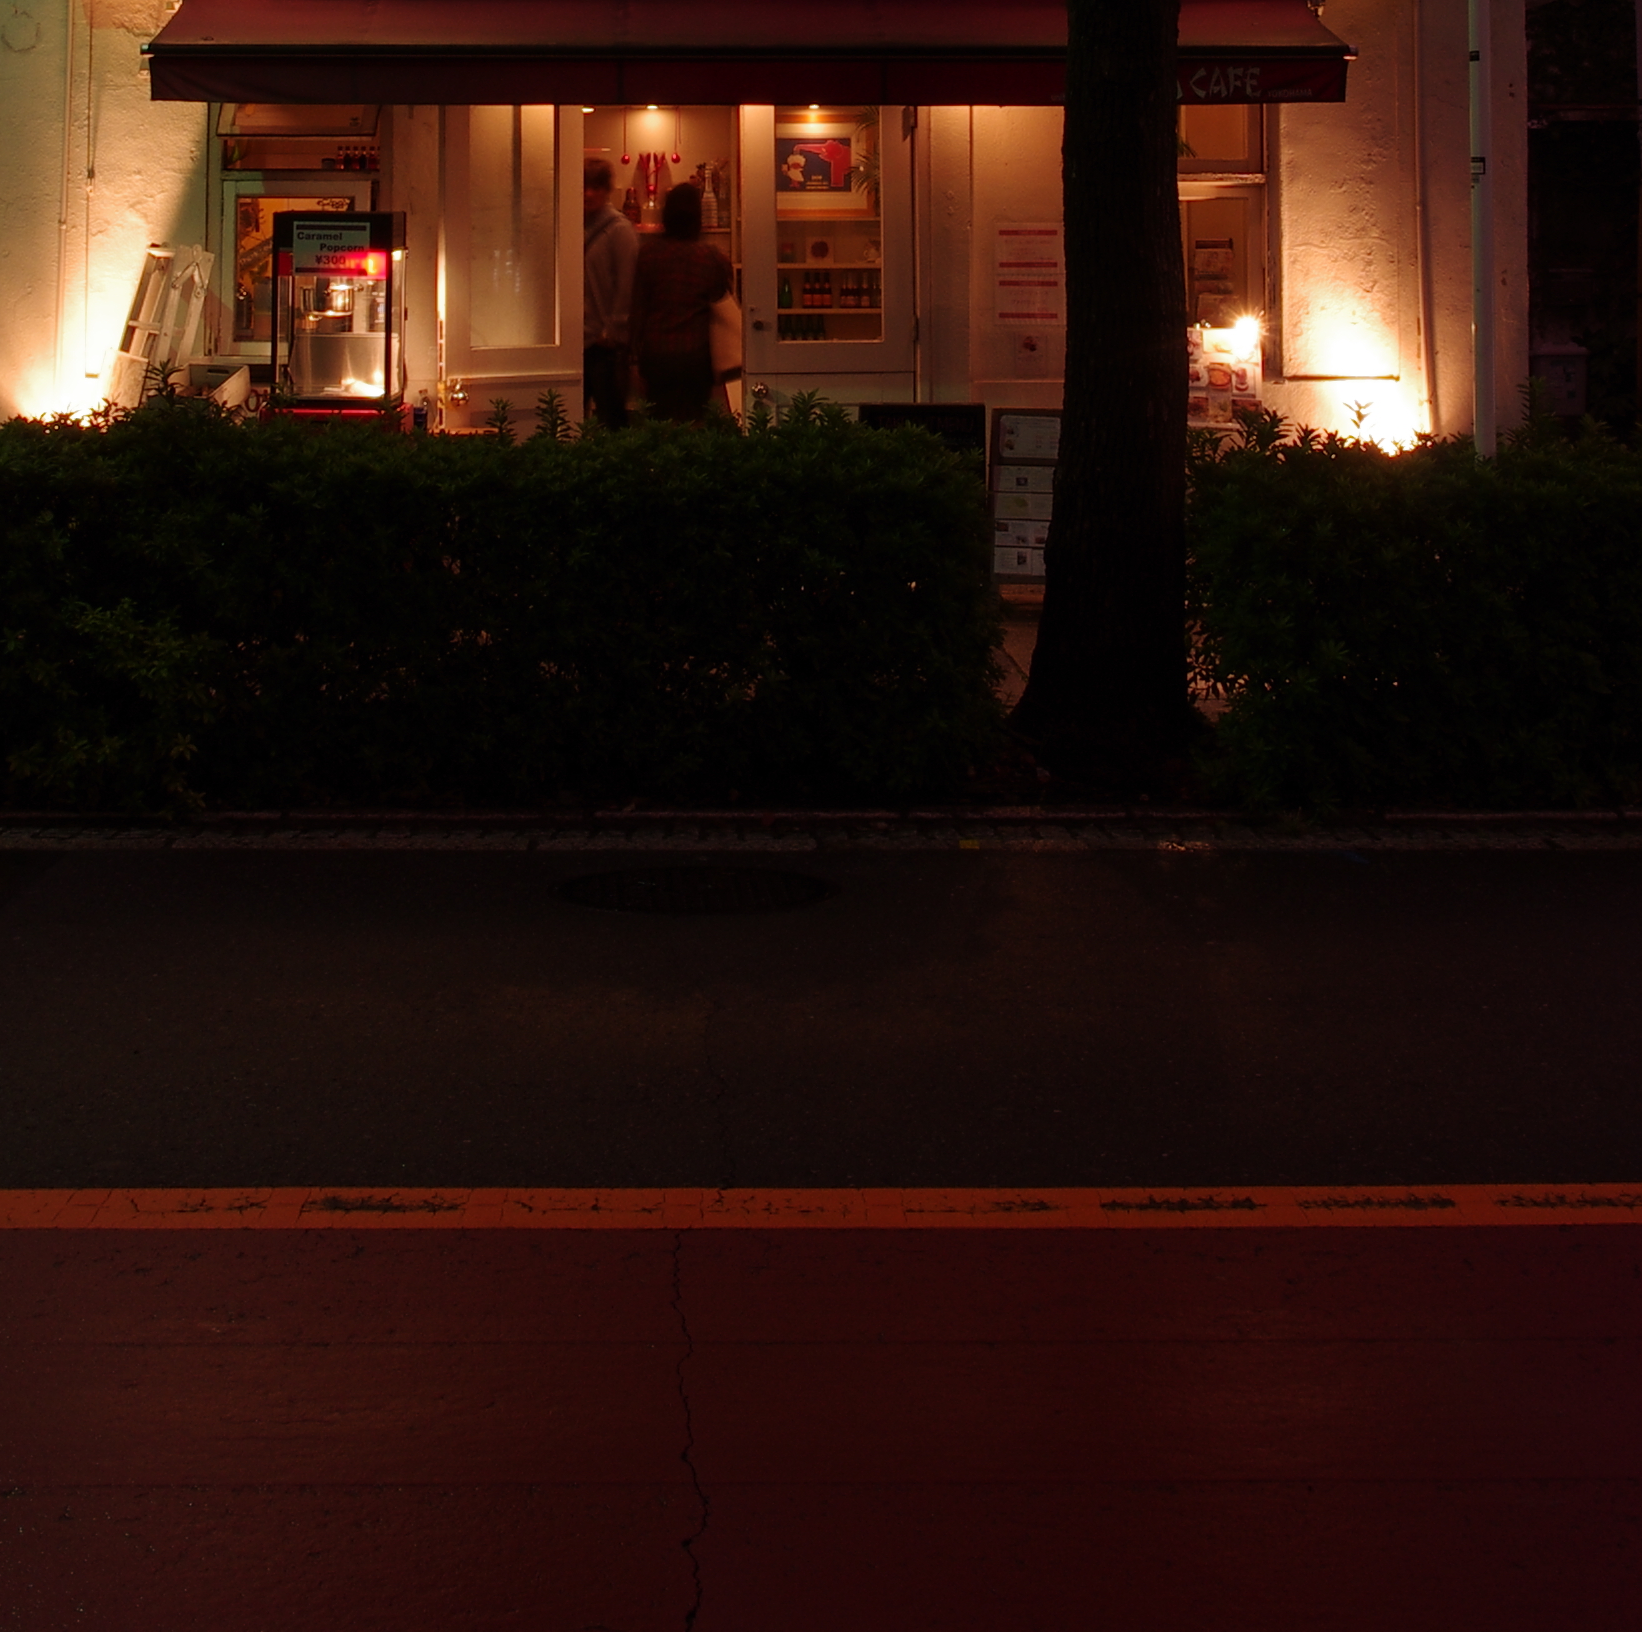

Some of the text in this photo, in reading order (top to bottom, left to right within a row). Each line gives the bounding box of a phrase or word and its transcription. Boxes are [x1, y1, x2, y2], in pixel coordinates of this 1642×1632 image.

[1189, 66, 1262, 100] CAFE
[1267, 87, 1313, 99] YOKOHAMA
[297, 232, 343, 240] Caramel
[320, 243, 365, 253] Popcorn
[315, 255, 346, 265] ¥300
